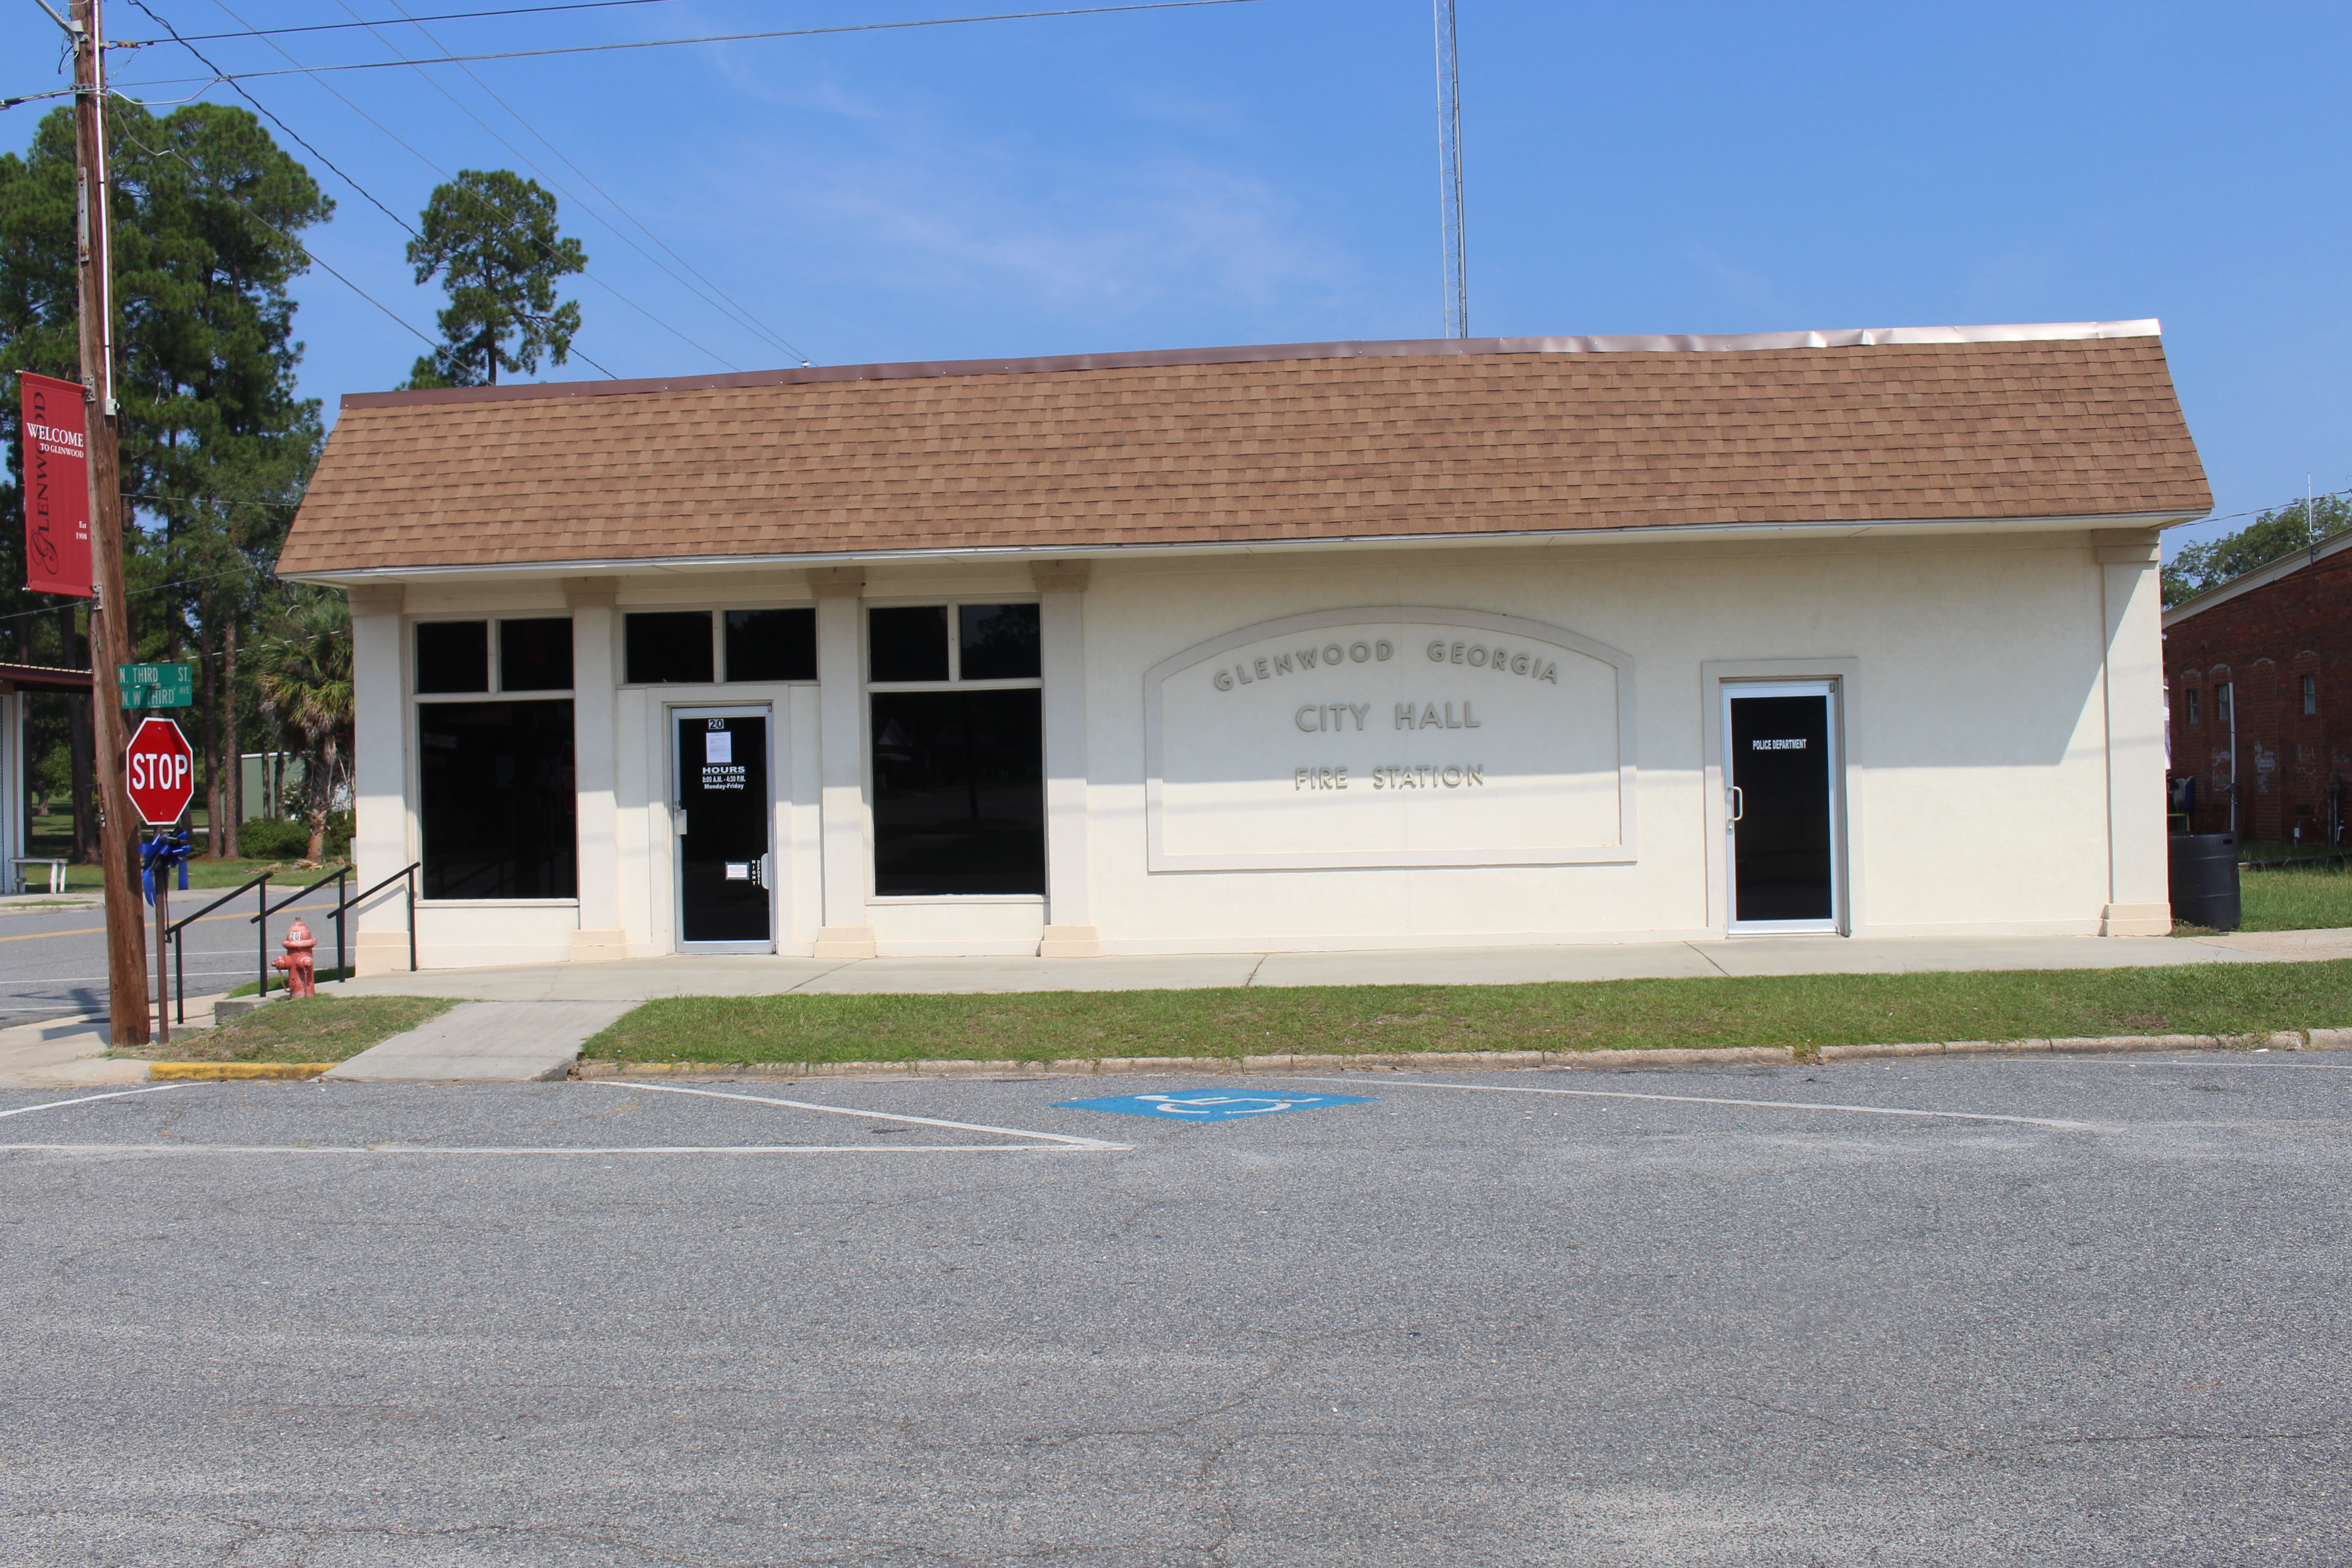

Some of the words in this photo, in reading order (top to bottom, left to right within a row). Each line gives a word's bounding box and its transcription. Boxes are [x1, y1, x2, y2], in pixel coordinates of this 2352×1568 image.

[26, 422, 84, 447] WELCOME
[40, 443, 49, 451] TO
[50, 445, 84, 458] GLENWOOD
[76, 532, 88, 540] 1908
[119, 667, 128, 683] N.
[132, 667, 158, 683] THIRD
[178, 666, 190, 682] ST.
[1214, 640, 1394, 691] GLENWOOD
[1427, 641, 1558, 685] GEORGIA
[147, 689, 174, 705] THIRD
[179, 686, 190, 694] AVE
[709, 719, 723, 729] 20
[1295, 702, 1371, 732] CITY
[1395, 701, 1481, 730] HALL
[1753, 740, 1772, 750] POLICE
[1772, 739, 1807, 750] DEPARTMENT
[132, 753, 188, 790] STOP
[1295, 766, 1349, 790] FIRE
[1372, 764, 1484, 789] STATION
